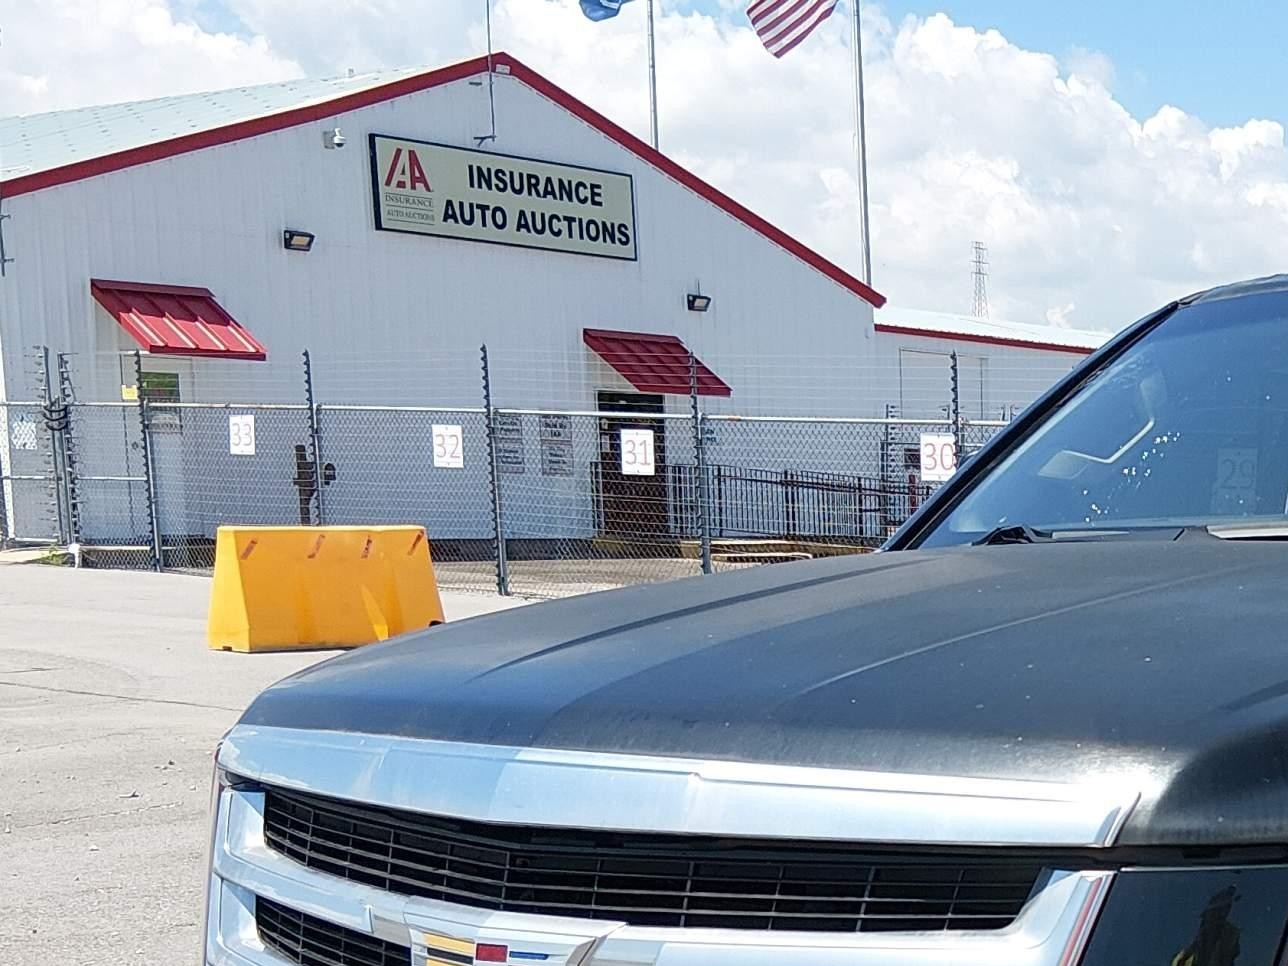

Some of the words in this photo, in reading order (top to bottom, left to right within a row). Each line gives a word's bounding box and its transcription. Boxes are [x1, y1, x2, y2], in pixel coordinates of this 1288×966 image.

[468, 164, 603, 207] INSURANCE
[385, 194, 433, 207] INSURANCE
[442, 199, 507, 230] AUTO
[515, 210, 630, 246] AUCTIONS
[231, 422, 252, 446] 33
[435, 433, 461, 459] 32
[624, 439, 652, 466] 31
[924, 442, 955, 473] 30
